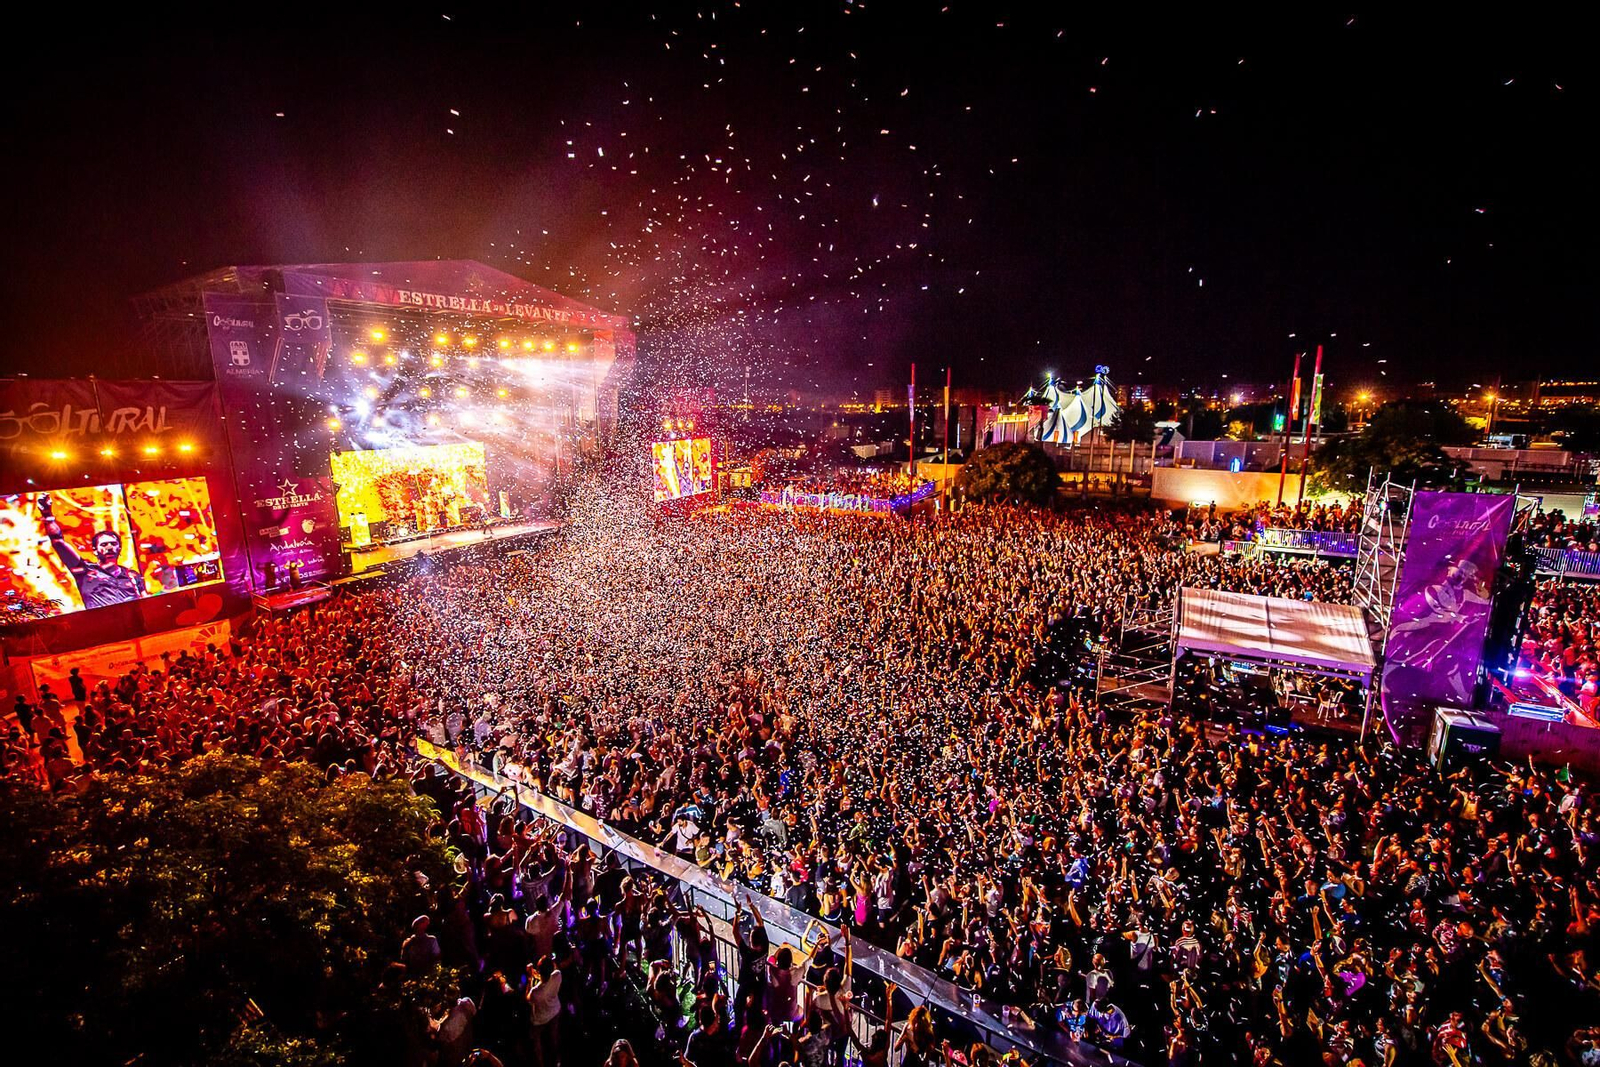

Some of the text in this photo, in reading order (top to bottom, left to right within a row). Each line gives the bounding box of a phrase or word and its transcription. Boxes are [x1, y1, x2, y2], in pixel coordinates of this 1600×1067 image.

[398, 289, 492, 312] ESTRELLA
[505, 304, 569, 322] LEVANTE
[255, 492, 321, 508] ESTRELLA
